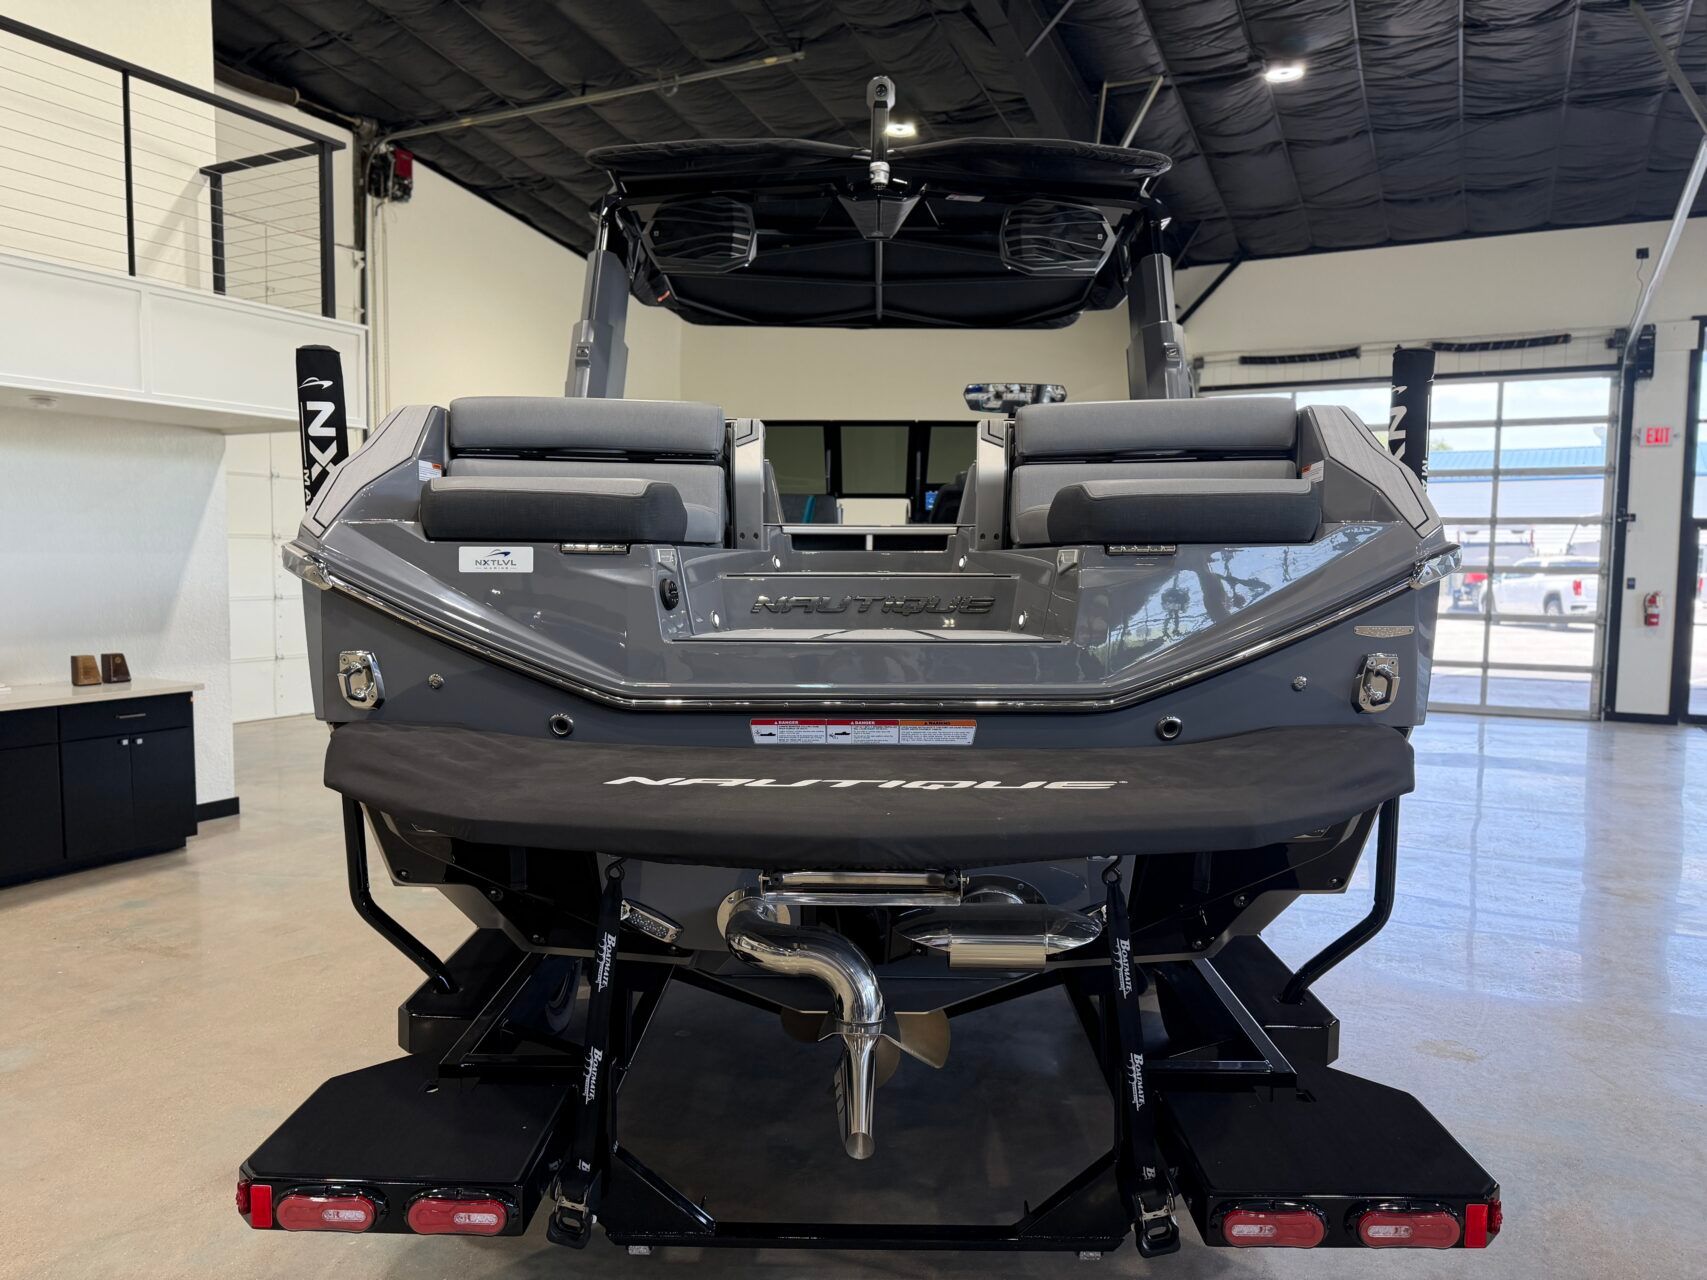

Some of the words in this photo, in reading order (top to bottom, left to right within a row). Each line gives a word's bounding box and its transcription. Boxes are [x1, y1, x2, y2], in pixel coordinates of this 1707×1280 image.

[1646, 427, 1671, 444] EXIT
[750, 595, 996, 616] NAUTIQUE
[603, 776, 1118, 790] NAUTIQUE
